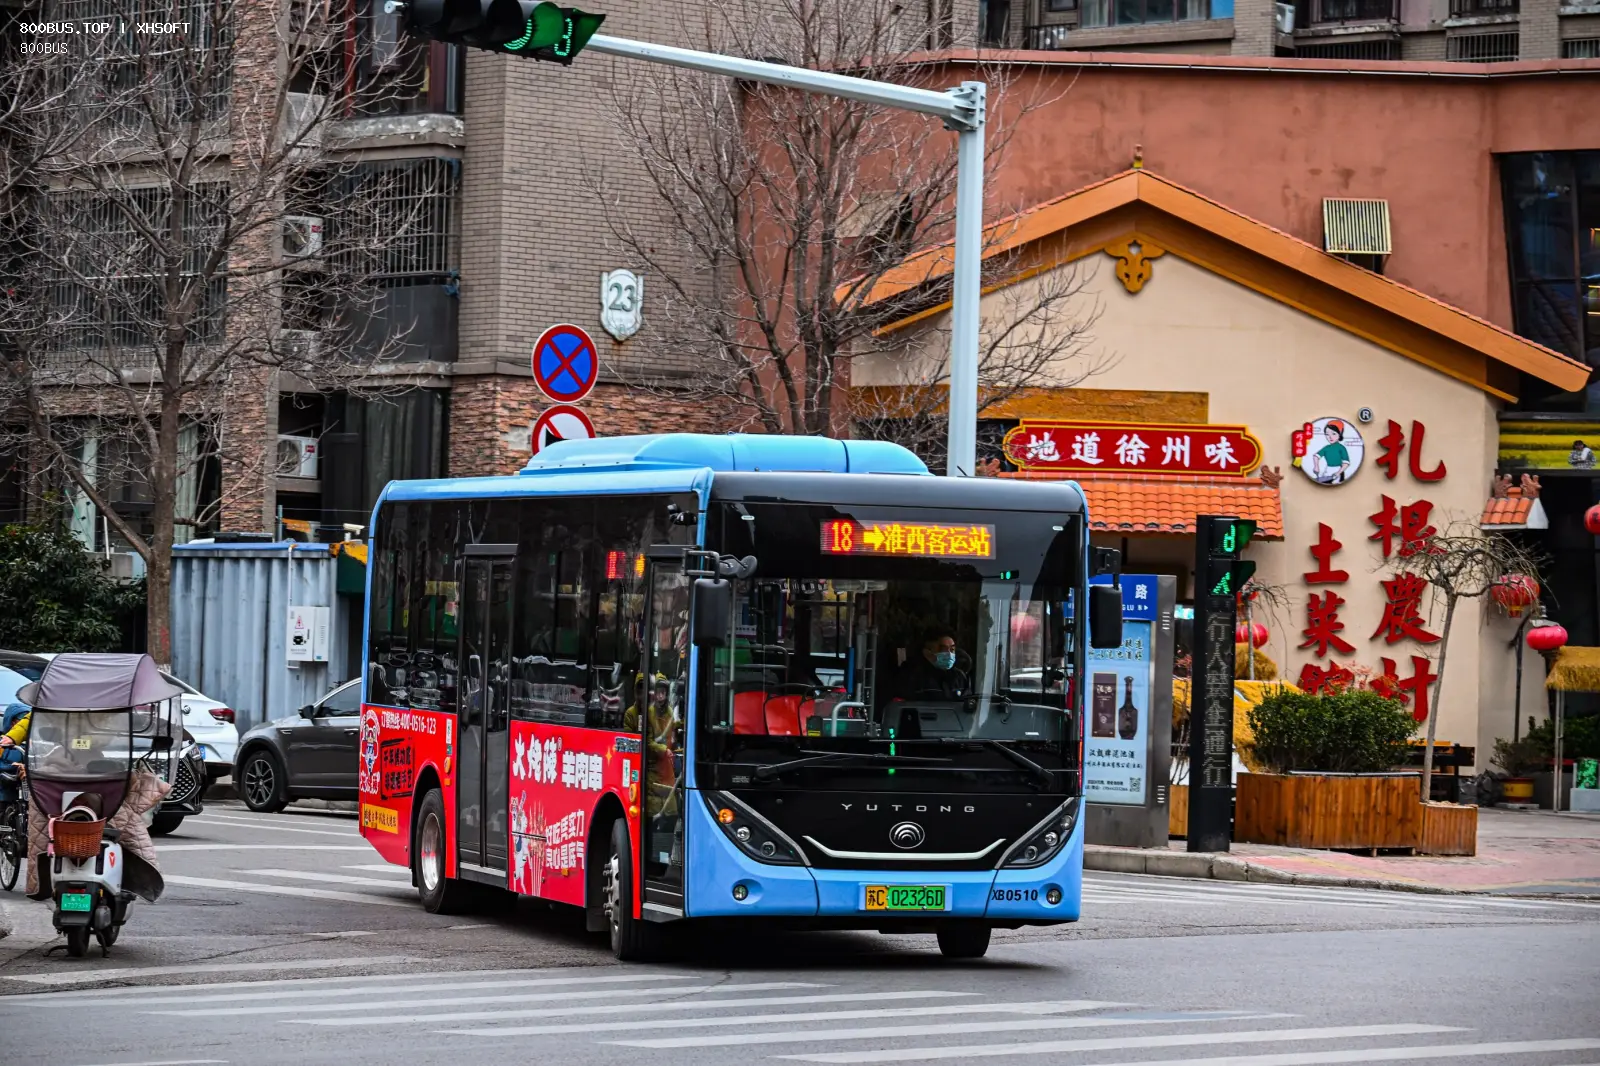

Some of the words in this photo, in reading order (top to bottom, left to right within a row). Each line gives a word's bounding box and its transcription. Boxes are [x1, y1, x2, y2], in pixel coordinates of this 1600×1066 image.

[608, 282, 635, 312] 23
[1026, 431, 1239, 469] 地道徐州味
[832, 521, 852, 552] 18
[884, 523, 992, 557] 淮西客运站
[561, 750, 603, 791] 羊肉串
[841, 803, 975, 813] YUTONG
[891, 889, 944, 907] 02326D
[991, 889, 1039, 902] XB0510
